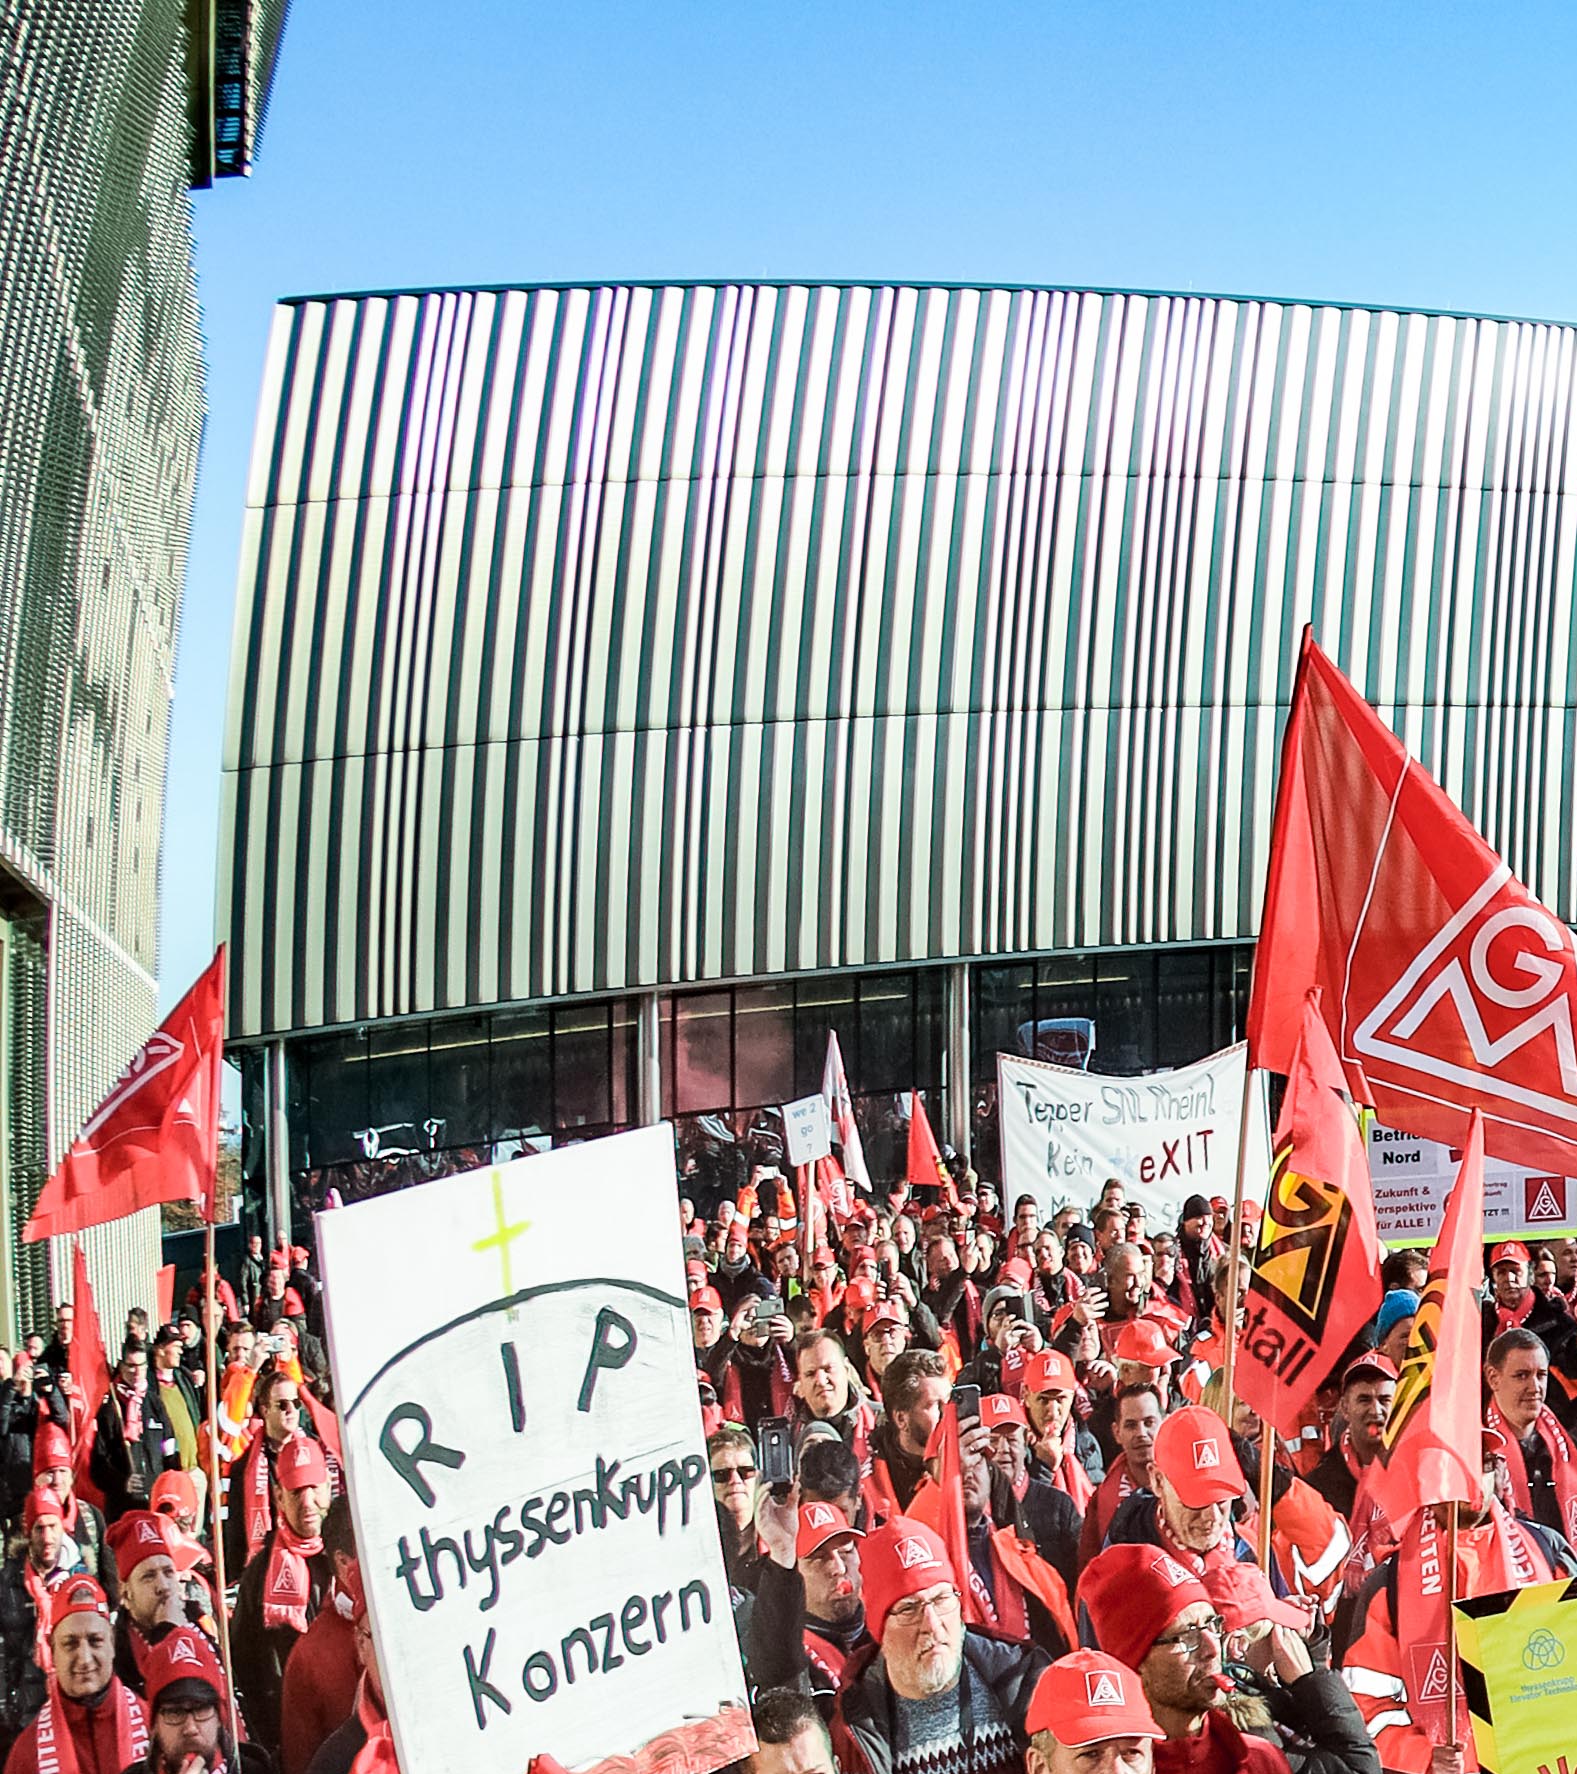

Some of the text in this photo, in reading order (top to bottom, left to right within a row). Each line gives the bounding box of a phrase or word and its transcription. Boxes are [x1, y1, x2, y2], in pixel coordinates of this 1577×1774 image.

[1383, 1150, 1421, 1165] Nord
[1375, 1186, 1419, 1199] Zukunft
[1395, 1219, 1424, 1230] ALLE
[462, 1573, 713, 1732] Konzern
